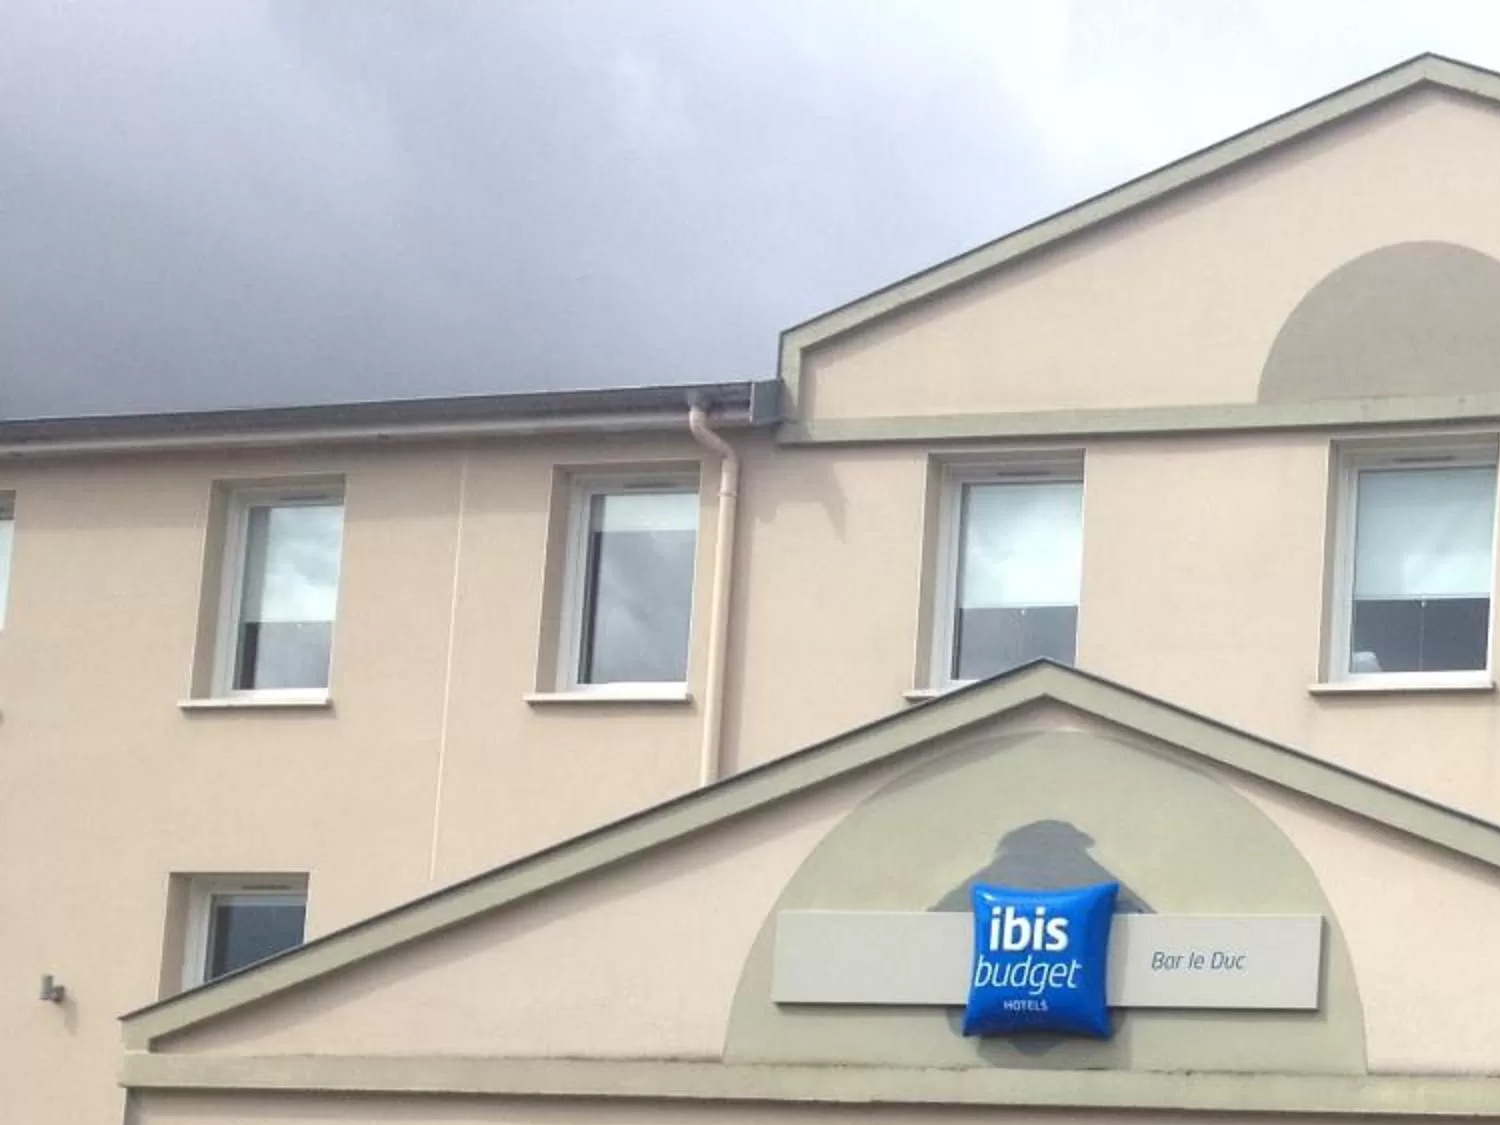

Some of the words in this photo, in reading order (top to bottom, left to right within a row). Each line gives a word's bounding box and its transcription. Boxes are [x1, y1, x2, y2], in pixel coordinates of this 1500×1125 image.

[989, 905, 1069, 952] ibis
[974, 953, 1082, 996] budget
[1151, 951, 1184, 970] Bar
[1188, 951, 1205, 970] le
[1210, 951, 1247, 970] Duc
[1003, 999, 1048, 1012] HOTELS
